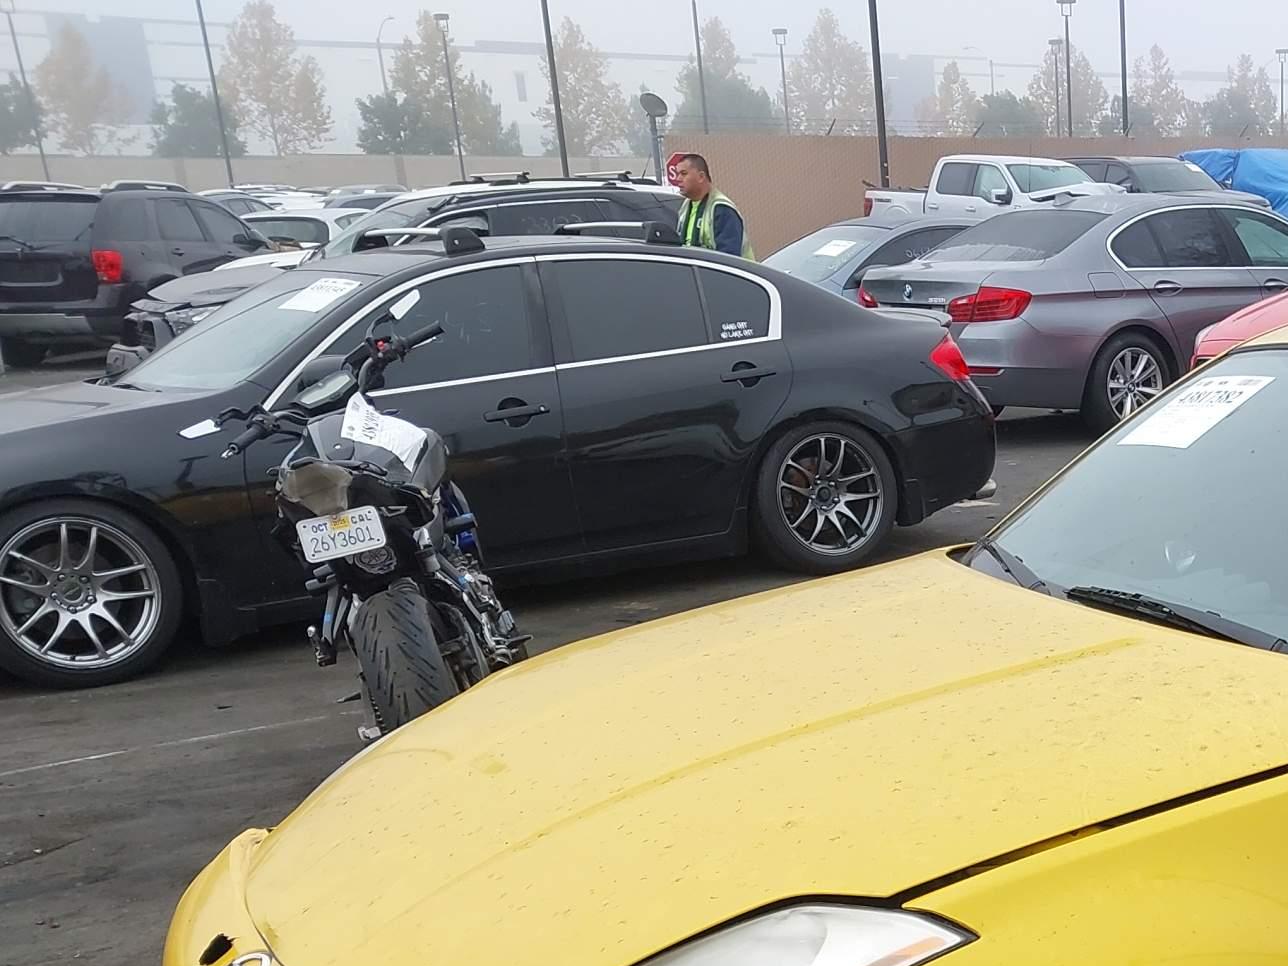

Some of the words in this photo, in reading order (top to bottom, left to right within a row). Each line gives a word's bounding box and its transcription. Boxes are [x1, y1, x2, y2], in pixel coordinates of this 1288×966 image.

[1177, 390, 1244, 404] 43817382
[311, 522, 328, 534] OCT
[350, 512, 372, 525] CAL
[310, 525, 375, 554] 26Y3601
